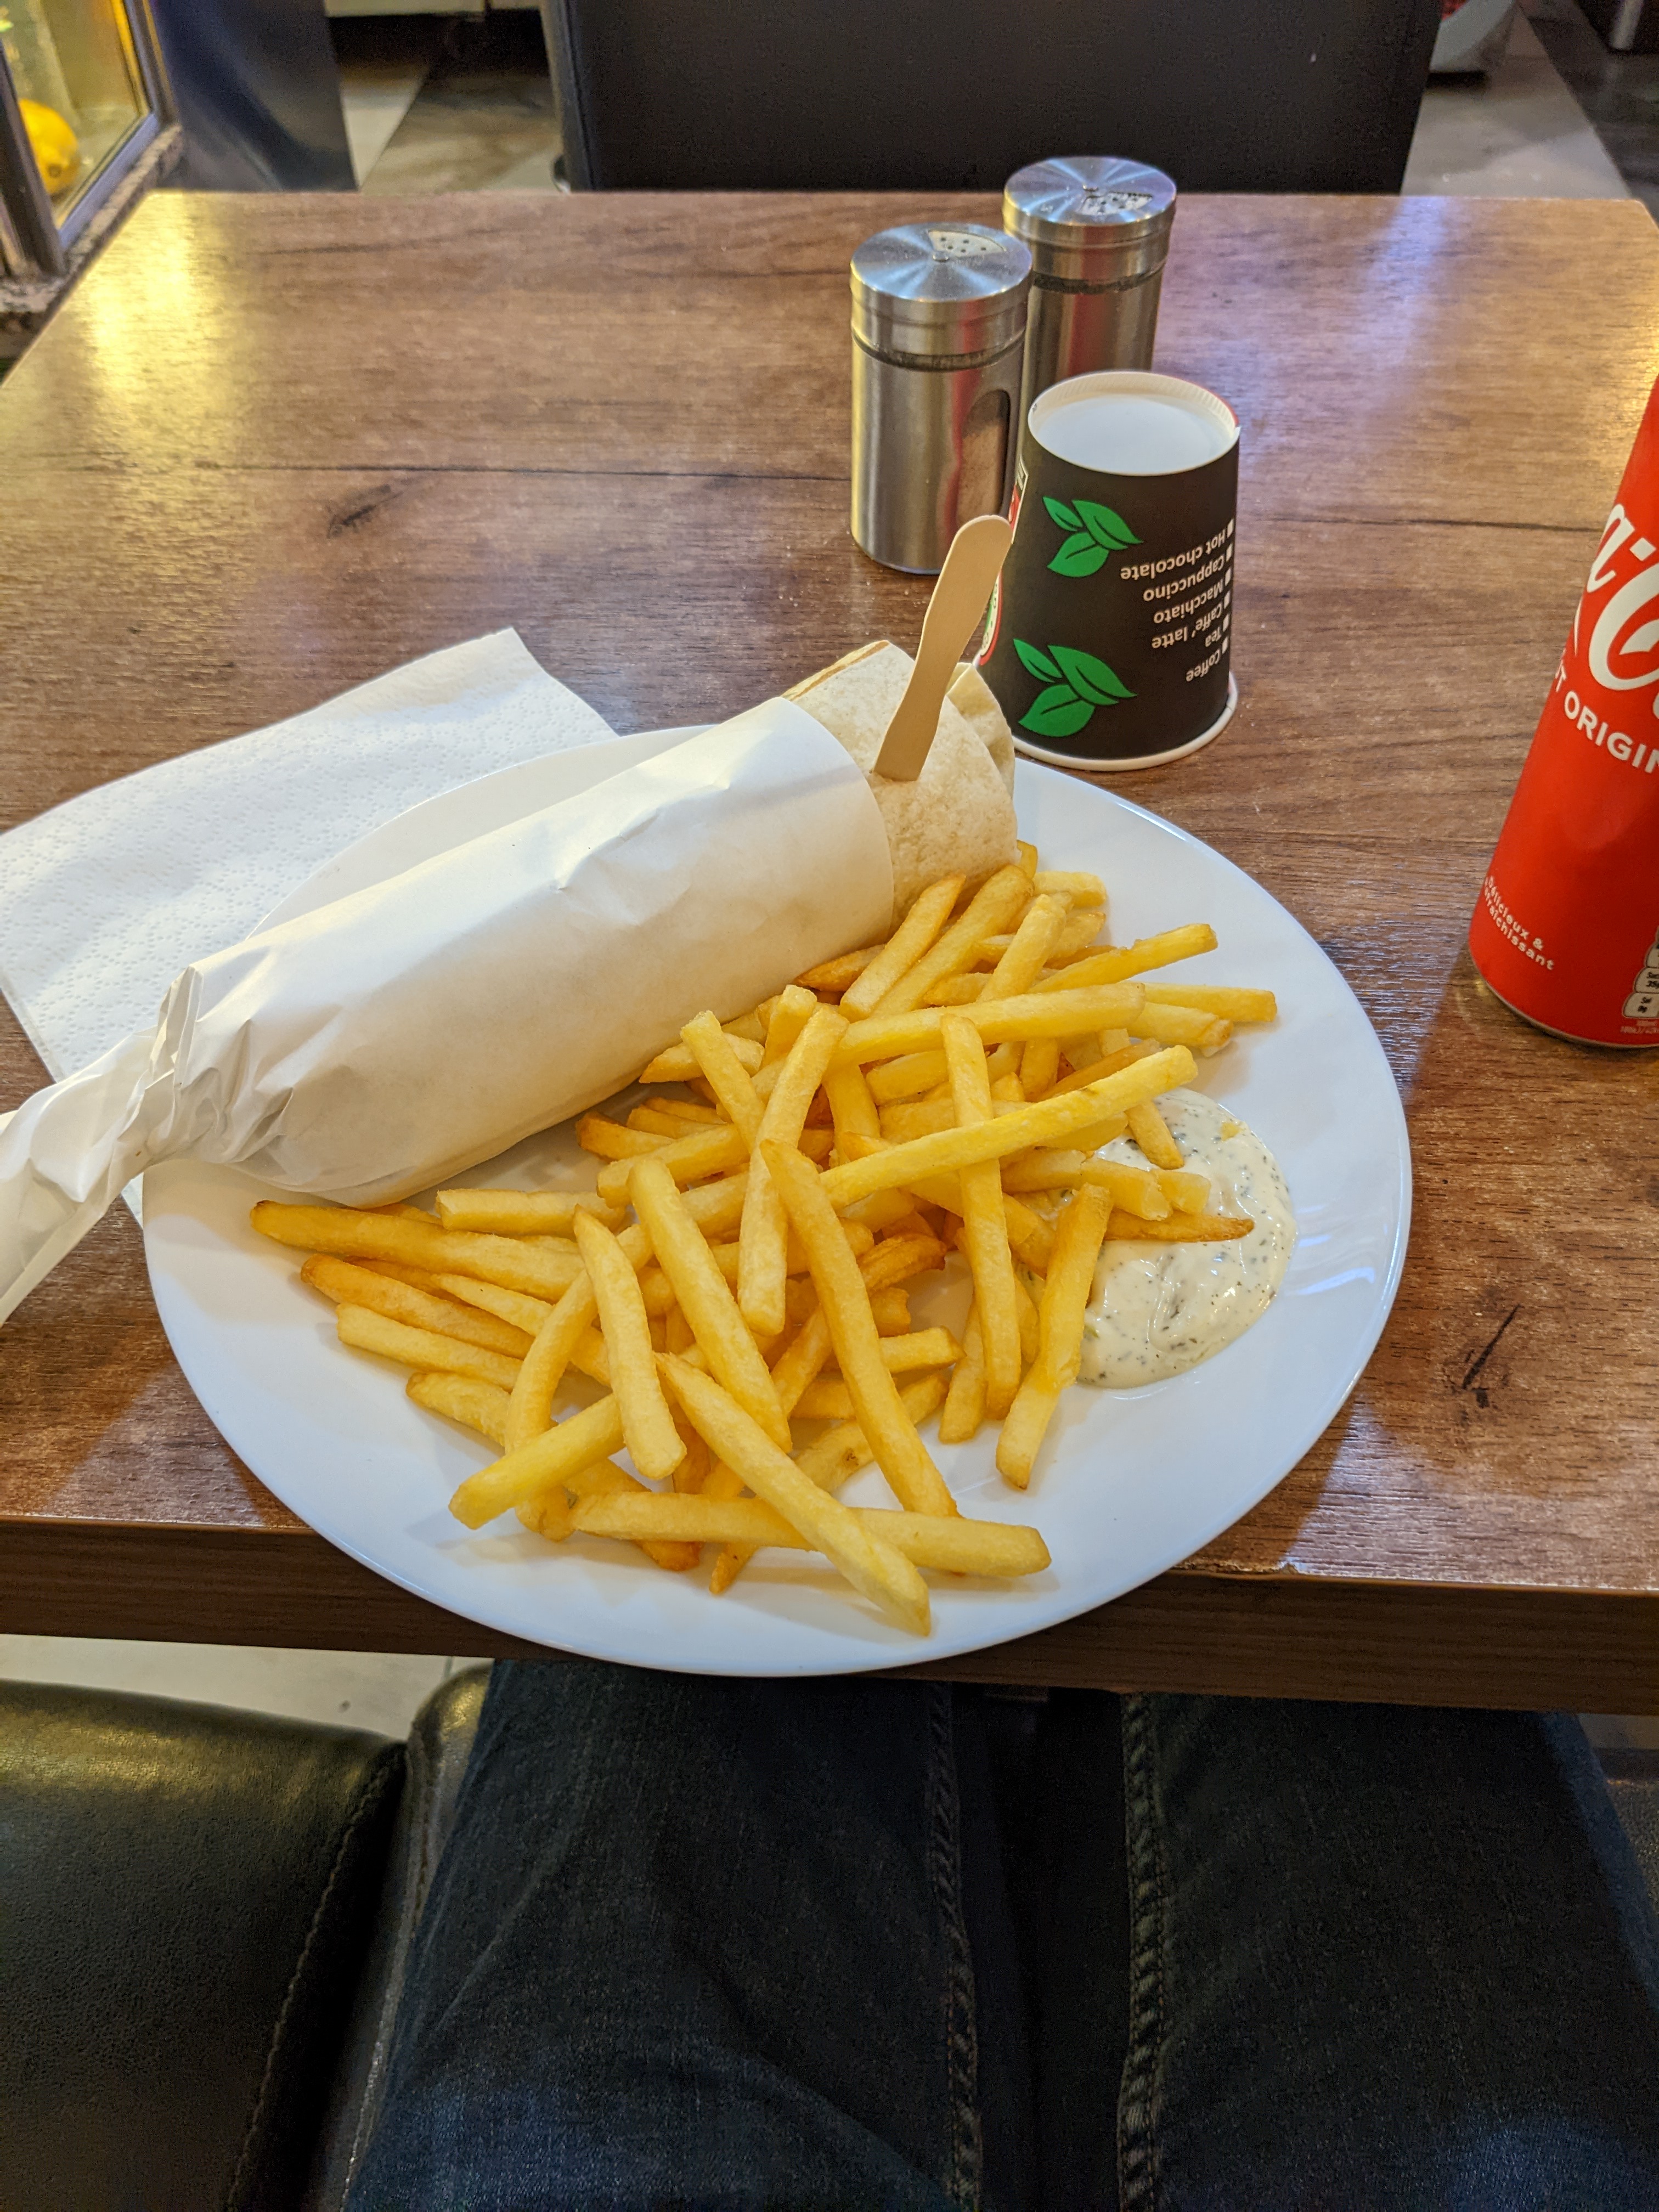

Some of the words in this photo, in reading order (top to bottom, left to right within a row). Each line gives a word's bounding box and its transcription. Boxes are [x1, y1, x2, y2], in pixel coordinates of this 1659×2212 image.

[1205, 528, 1227, 555] Hot
[1120, 546, 1203, 580] chocolate
[1142, 553, 1225, 602] Cappuccino
[1153, 579, 1223, 624] Macchiato
[1152, 627, 1188, 648] latte
[1205, 627, 1222, 647] Tea
[1186, 648, 1221, 682] Coffee
